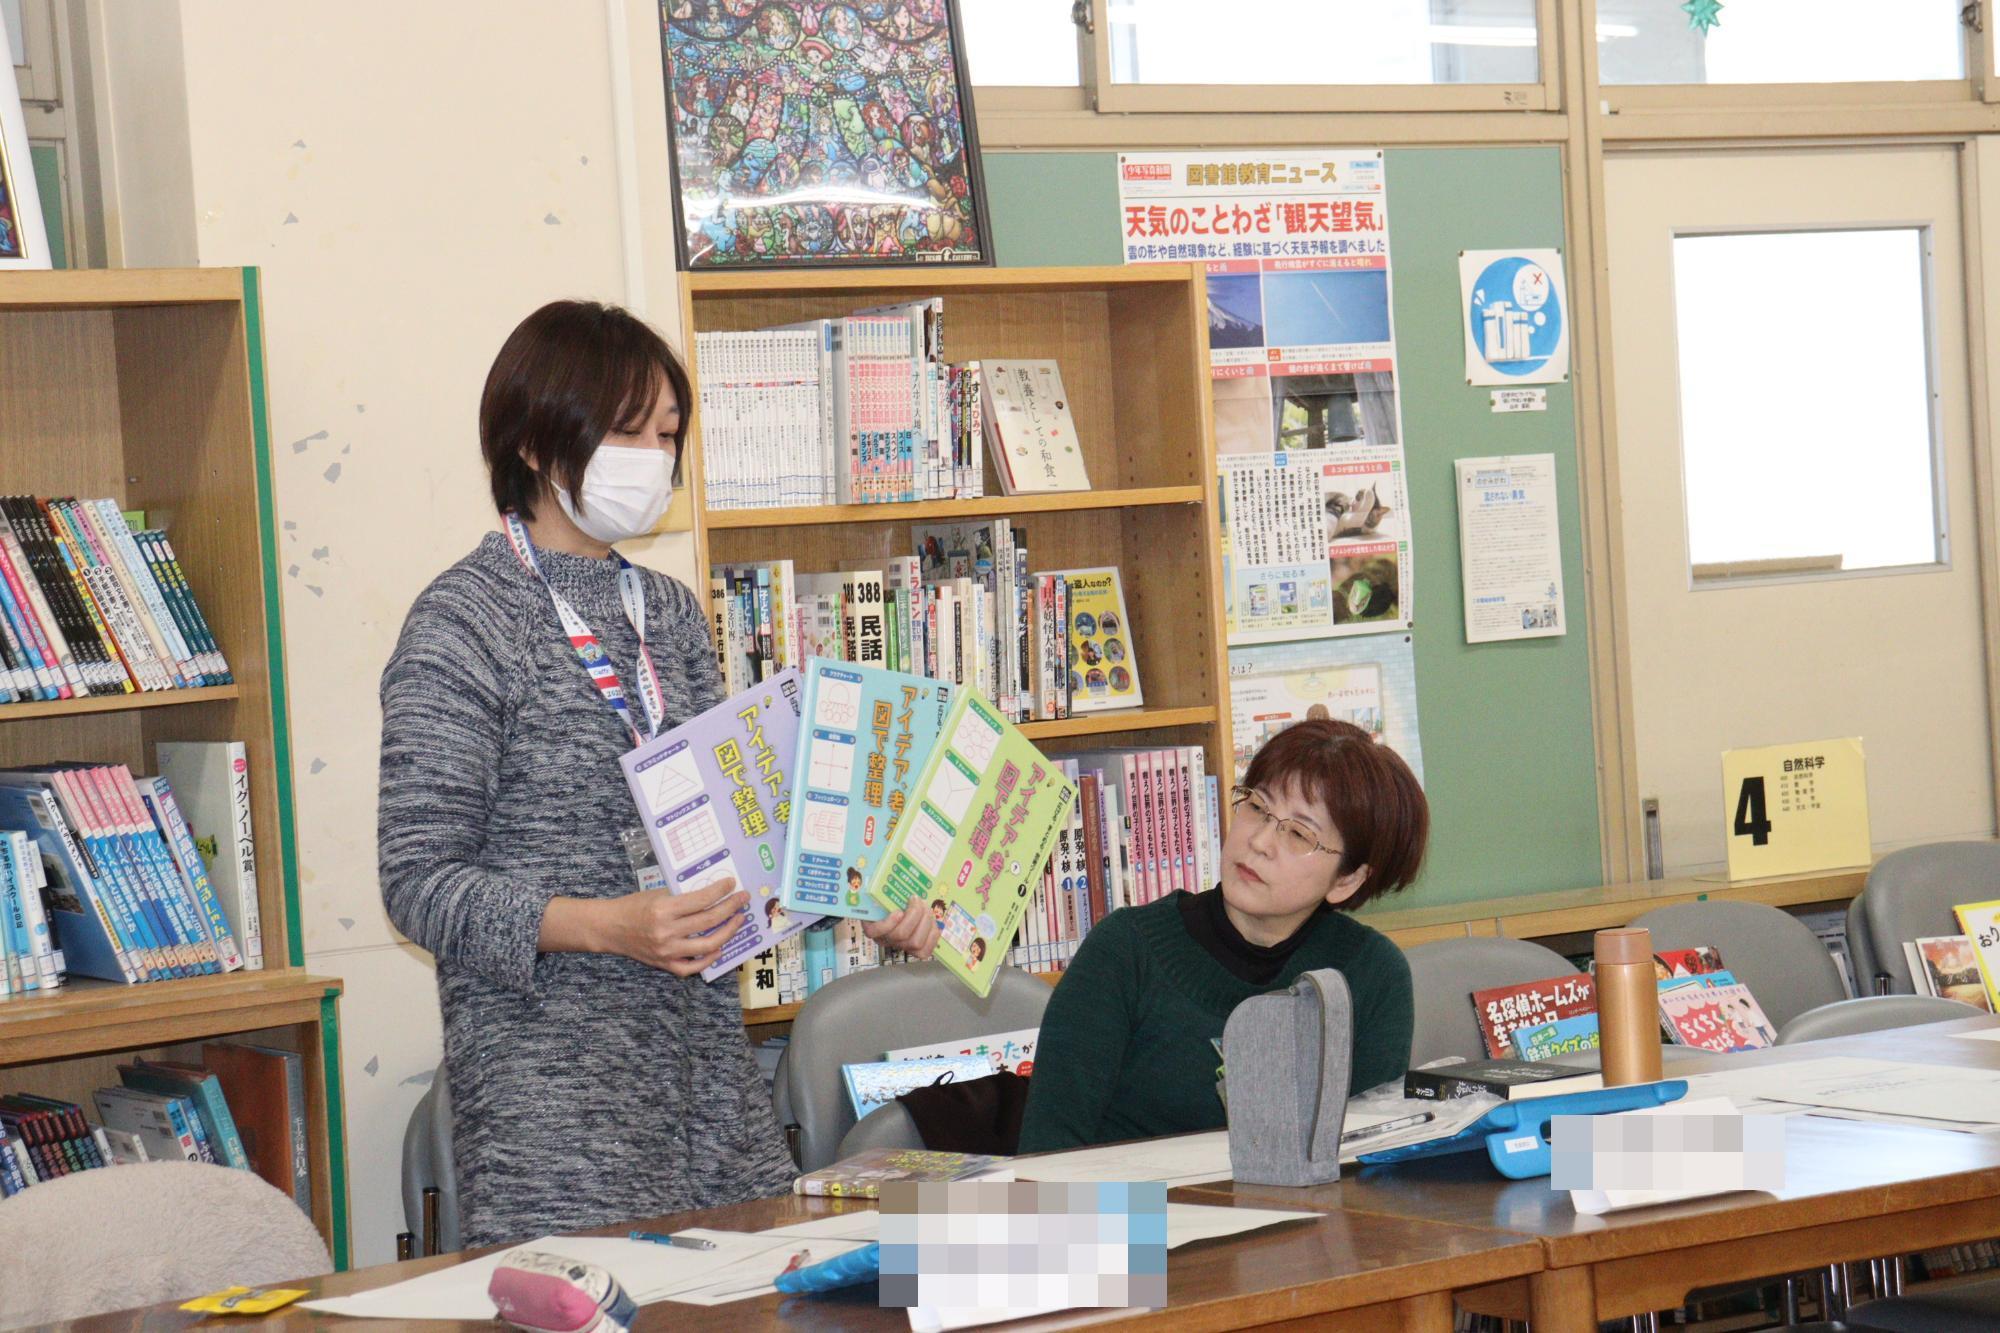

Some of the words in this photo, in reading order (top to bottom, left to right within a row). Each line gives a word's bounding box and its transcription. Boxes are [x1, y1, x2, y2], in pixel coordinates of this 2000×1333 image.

[1186, 162, 1337, 186] 図書館教育ニュース
[1126, 201, 1384, 237] 天気のことわざ「観天望気」
[1017, 367, 1057, 478] 教養としての和食
[712, 589, 725, 599] 386
[858, 582, 881, 603] 388
[910, 562, 921, 618] ドラゴン
[860, 615, 883, 661] 民話
[737, 704, 792, 825] アイデア、考
[864, 699, 892, 807] 図で整理
[1783, 756, 1825, 772] 自然科学
[713, 738, 769, 839] 図で整理
[969, 760, 1021, 860] 図で整理
[1734, 776, 1772, 846] 4
[234, 774, 255, 873] イグ・ノーベル賞
[1060, 829, 1071, 873] 原発・核
[1074, 828, 1086, 871] 原発・核
[1486, 979, 1591, 1024] 名探偵ホームズが
[1680, 1010, 1726, 1039] ちくちく
